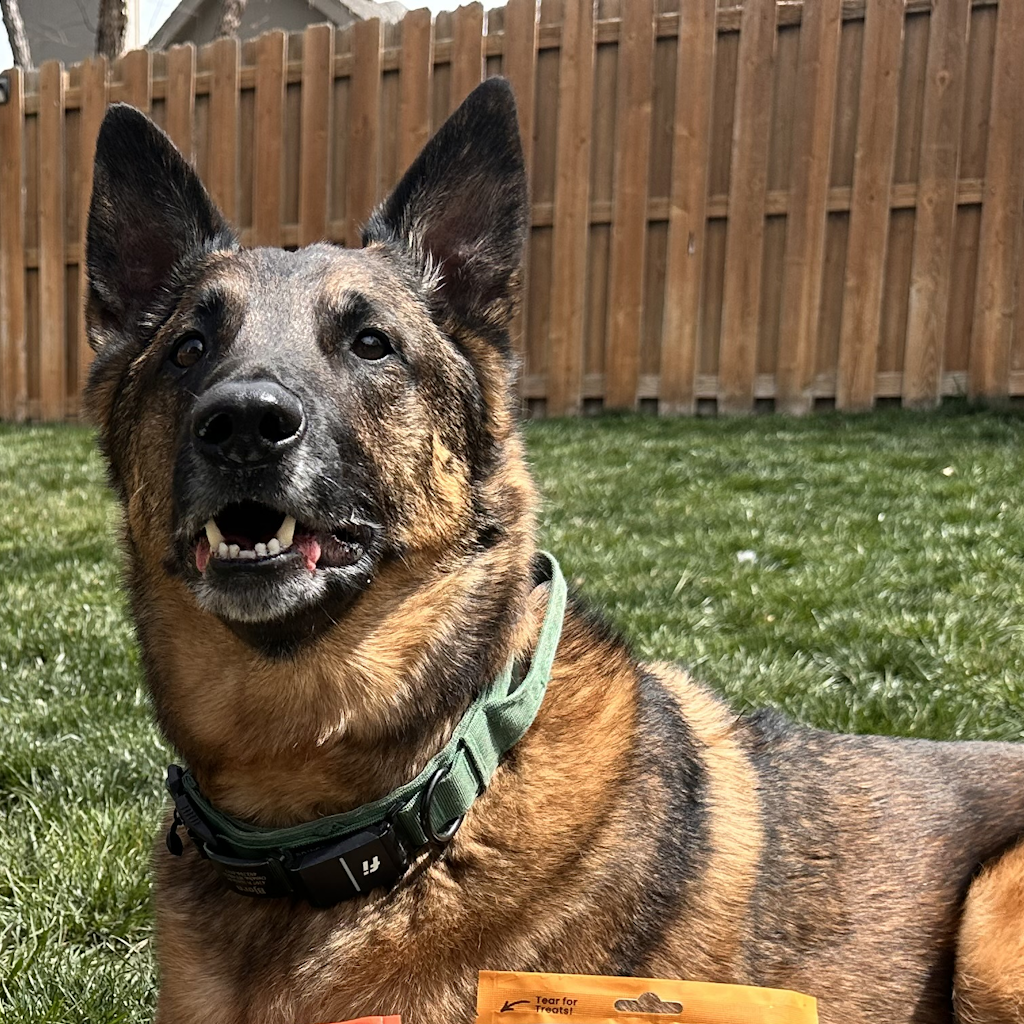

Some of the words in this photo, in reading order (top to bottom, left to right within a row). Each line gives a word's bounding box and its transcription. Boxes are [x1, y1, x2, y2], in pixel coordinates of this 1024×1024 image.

[535, 996, 560, 1004] Tear
[563, 997, 578, 1005] for
[535, 1005, 573, 1015] Treats!
